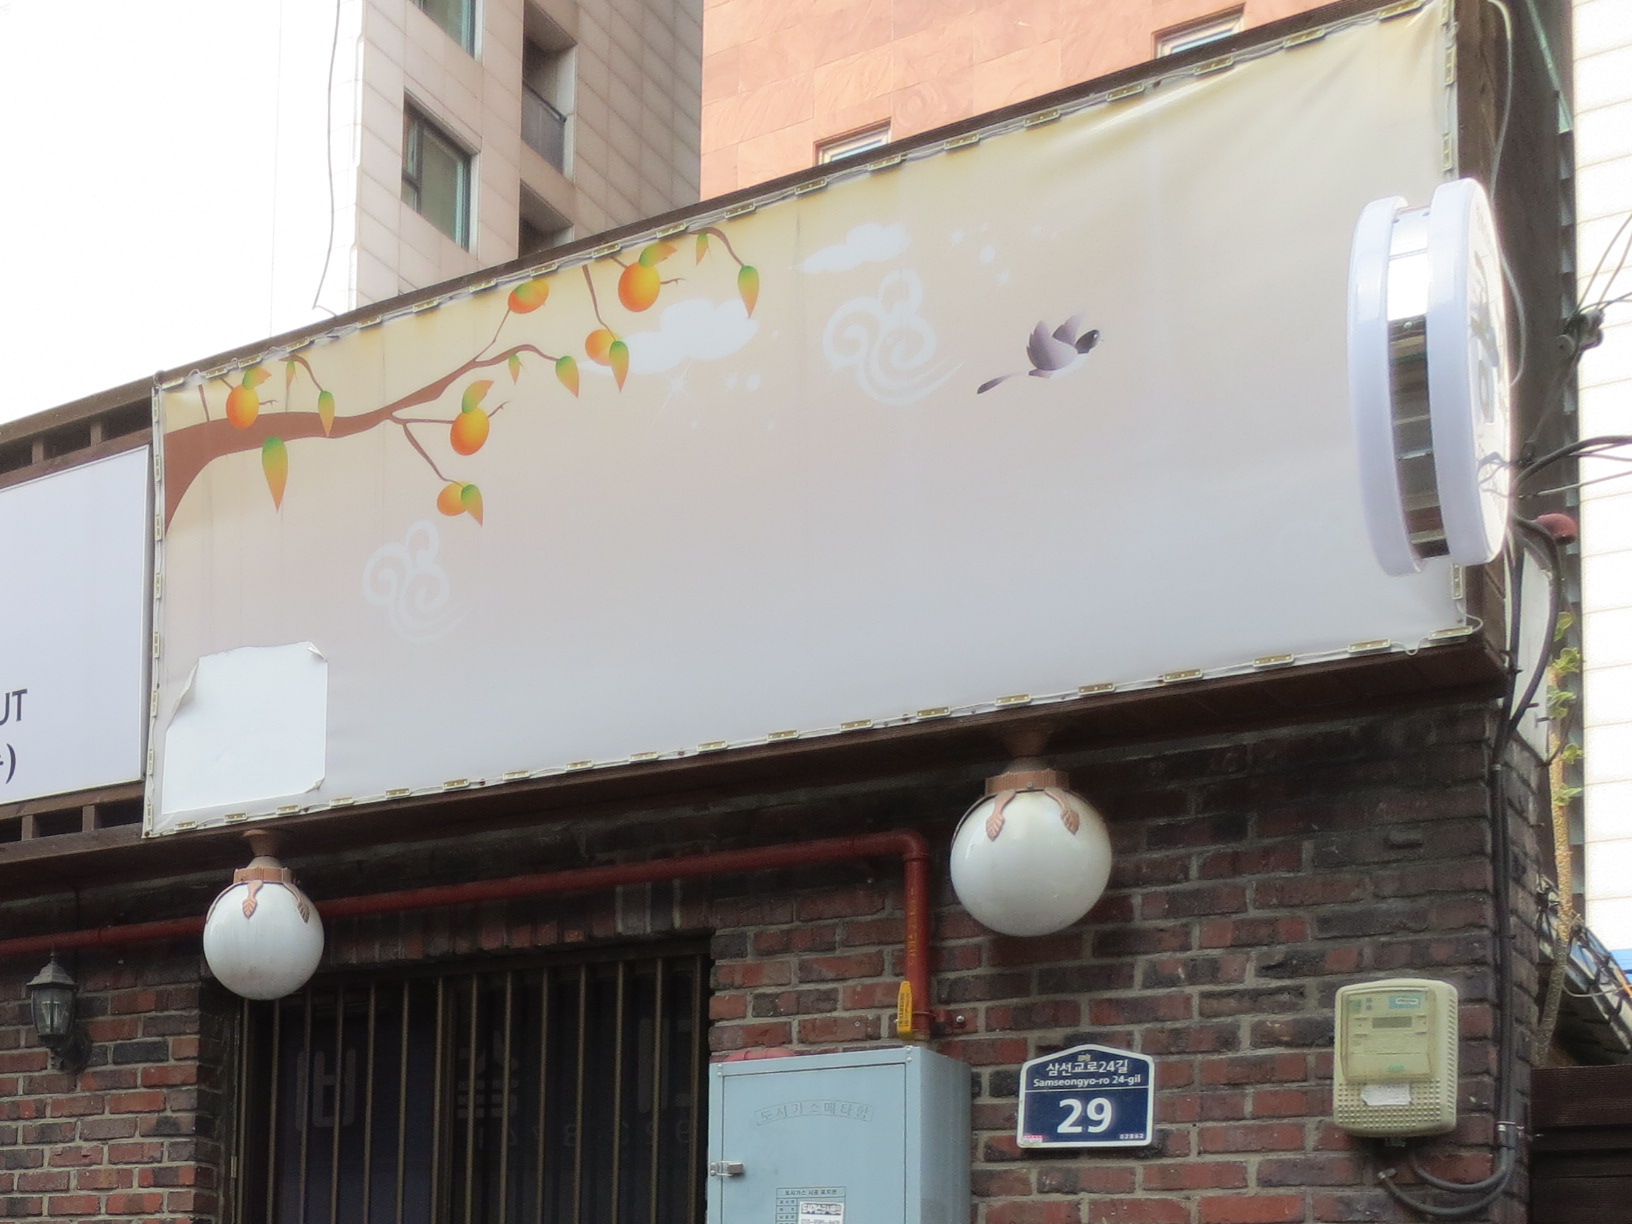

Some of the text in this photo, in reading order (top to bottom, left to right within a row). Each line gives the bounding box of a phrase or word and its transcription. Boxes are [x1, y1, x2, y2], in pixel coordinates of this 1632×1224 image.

[1045, 1059, 1129, 1077] 삼선교로24길
[1033, 1074, 1141, 1088] Samseongyo-ro 24-gil
[1056, 1097, 1113, 1134] 29
